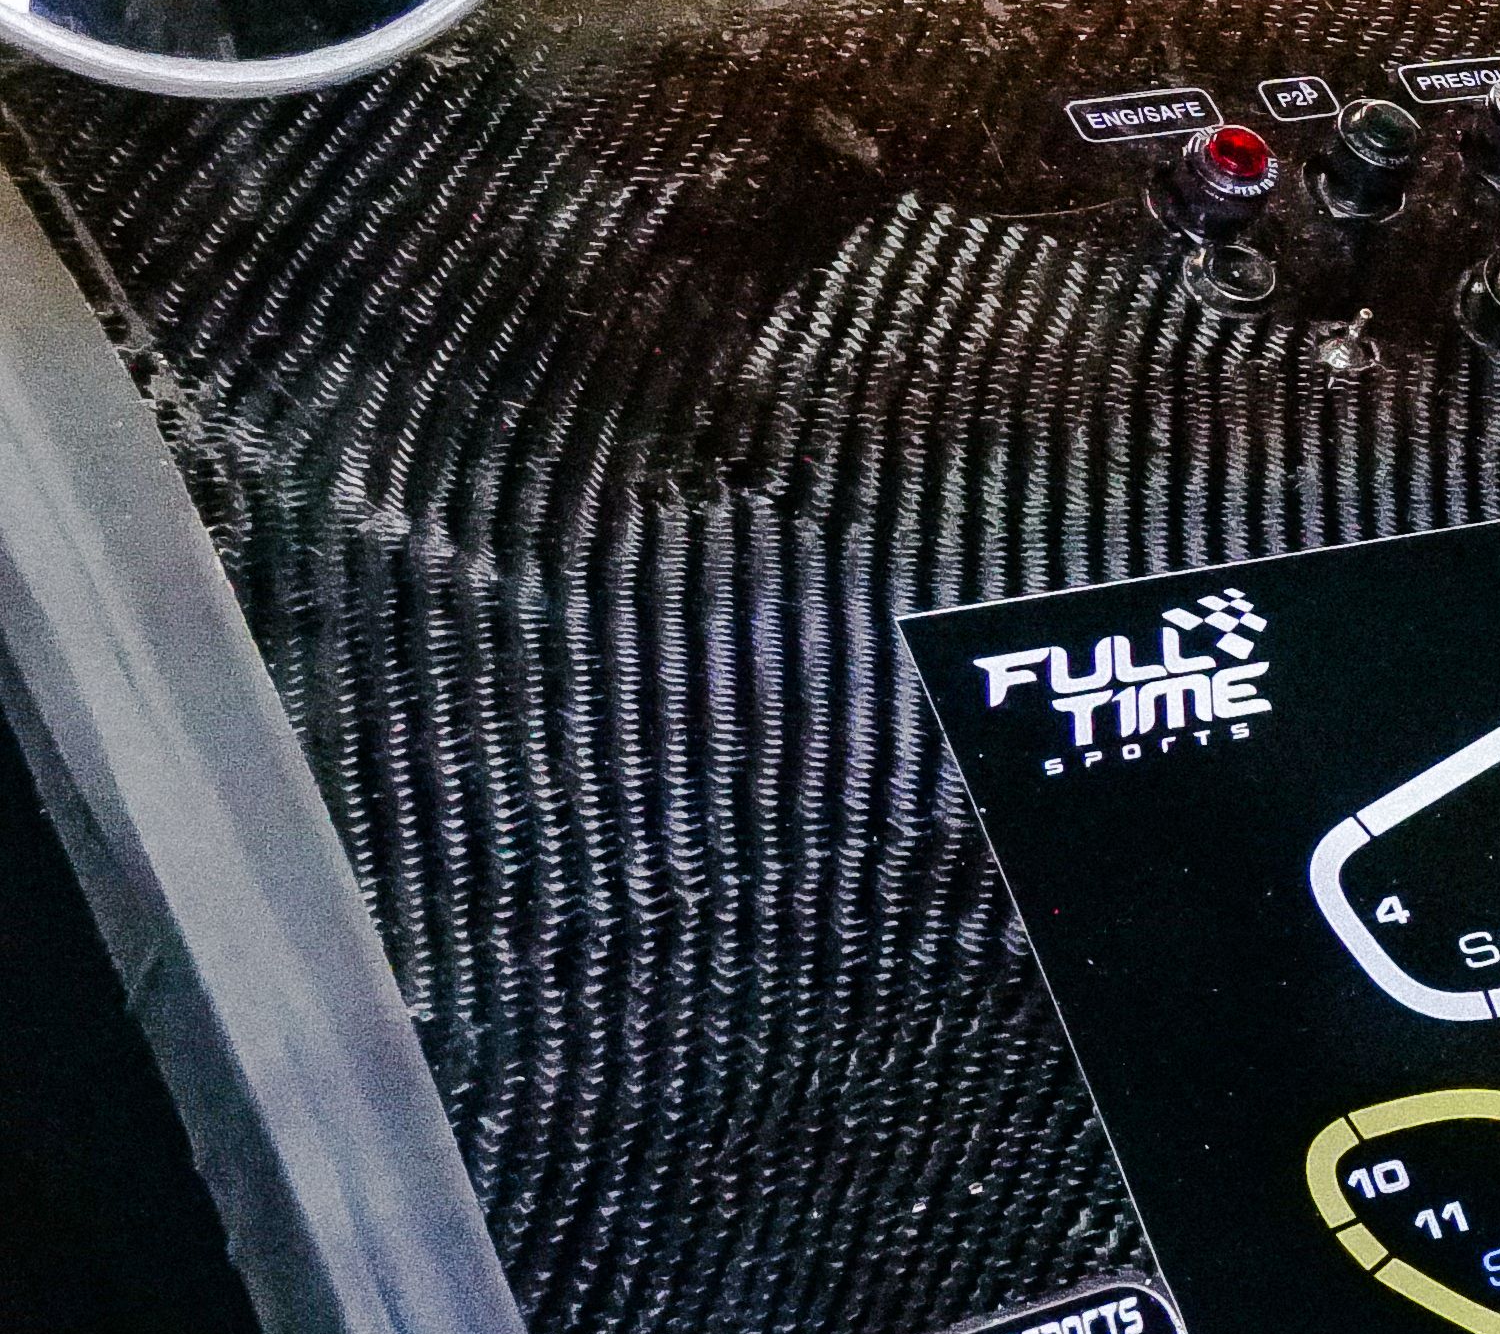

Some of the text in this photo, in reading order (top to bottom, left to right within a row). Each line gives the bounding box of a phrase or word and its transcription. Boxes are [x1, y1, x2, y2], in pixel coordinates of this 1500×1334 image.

[1086, 101, 1206, 129] ENG/SAFE
[972, 626, 1217, 708] FULL
[1376, 896, 1410, 926] 4
[1348, 1159, 1411, 1200] 10
[1413, 1200, 1471, 1241] 11
